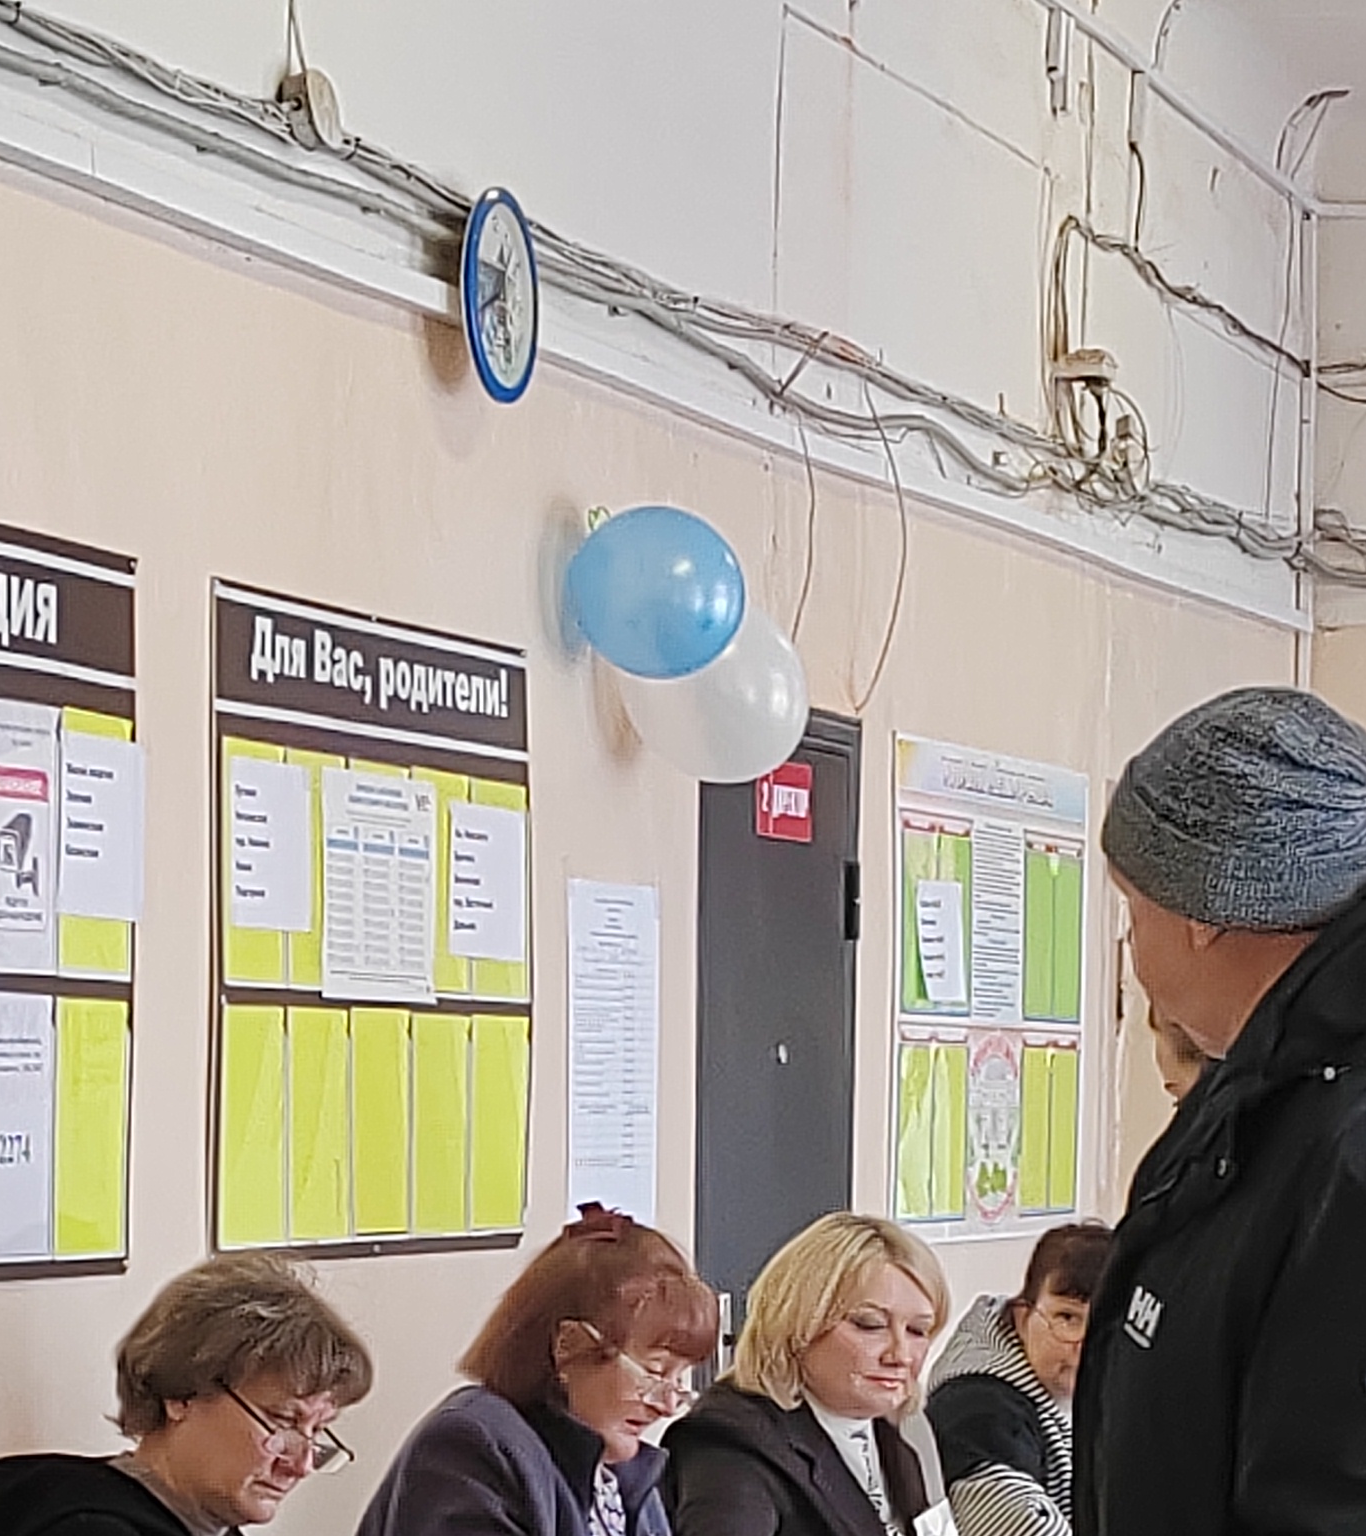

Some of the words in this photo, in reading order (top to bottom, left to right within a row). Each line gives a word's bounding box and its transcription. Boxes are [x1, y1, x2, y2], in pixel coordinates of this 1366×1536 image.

[250, 615, 306, 682] Для
[313, 630, 373, 704] Вас,
[380, 656, 510, 718] родители!
